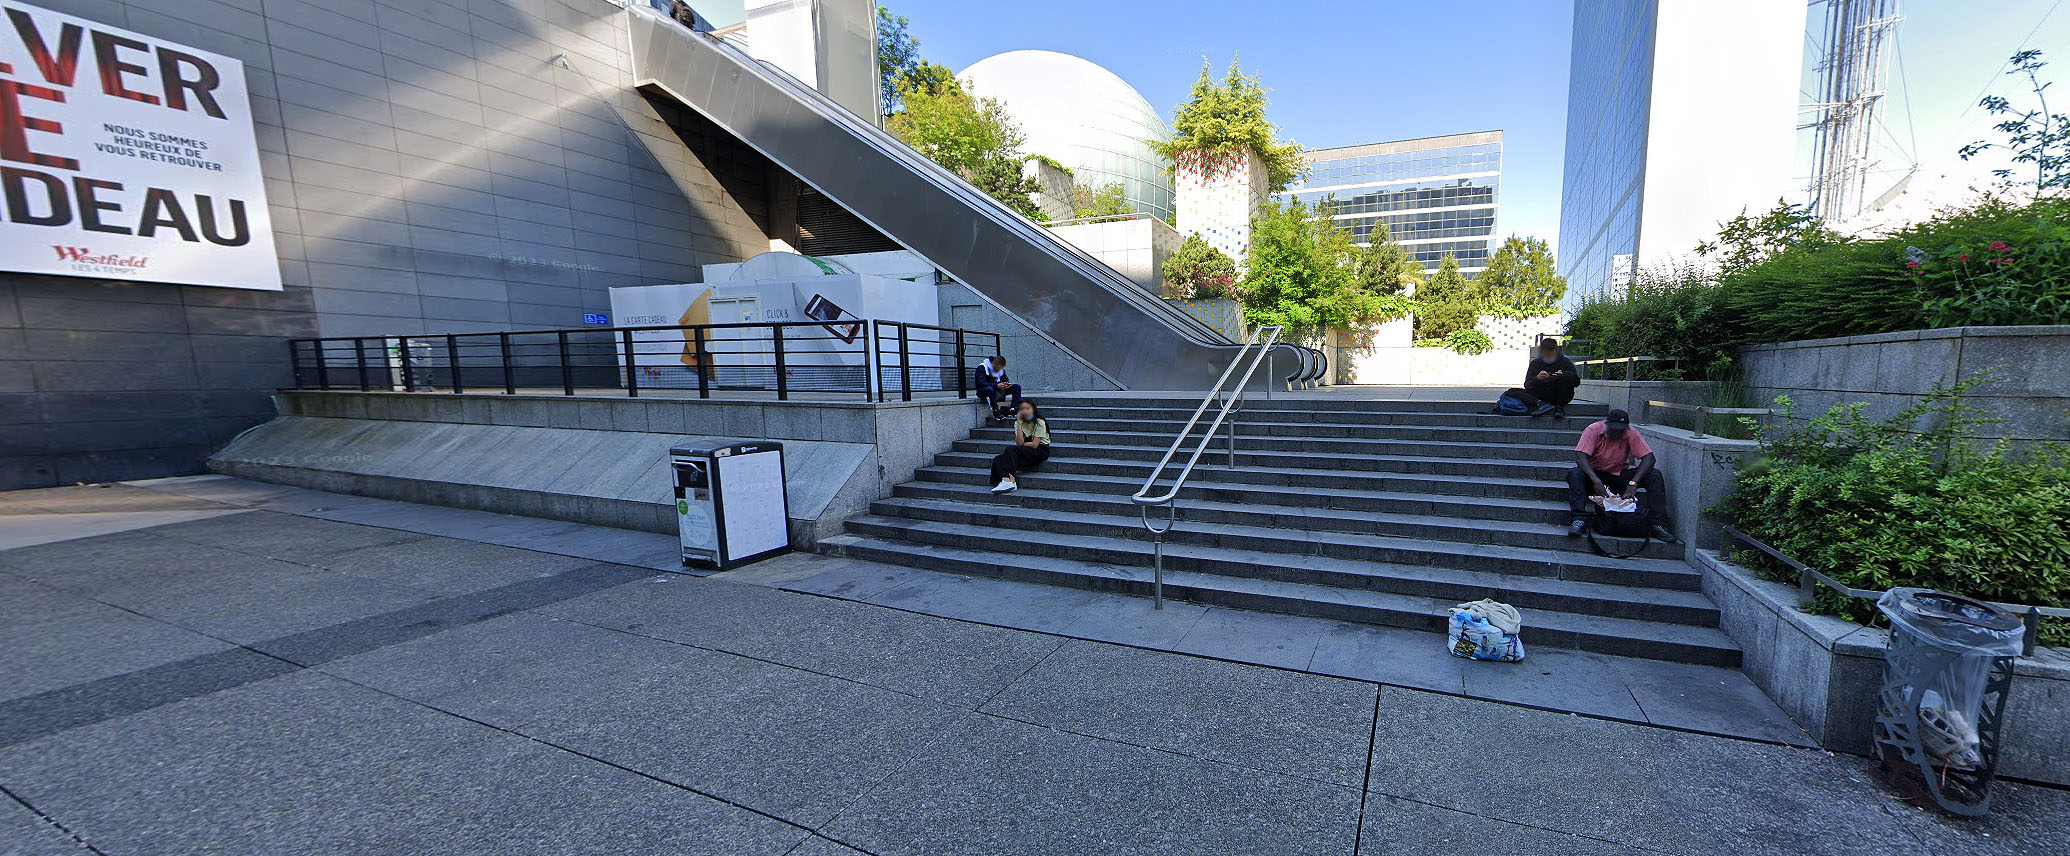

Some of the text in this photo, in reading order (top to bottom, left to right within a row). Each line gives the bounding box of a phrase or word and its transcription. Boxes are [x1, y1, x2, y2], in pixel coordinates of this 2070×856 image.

[0, 6, 228, 120] VER
[104, 123, 208, 150] NOUS SOMMES
[113, 136, 203, 159] HEUREUX DE
[94, 142, 222, 172] VOUS RETROUVER
[0, 165, 250, 247] DEAU
[50, 245, 149, 267] Westfield
[767, 309, 783, 318] CLICK
